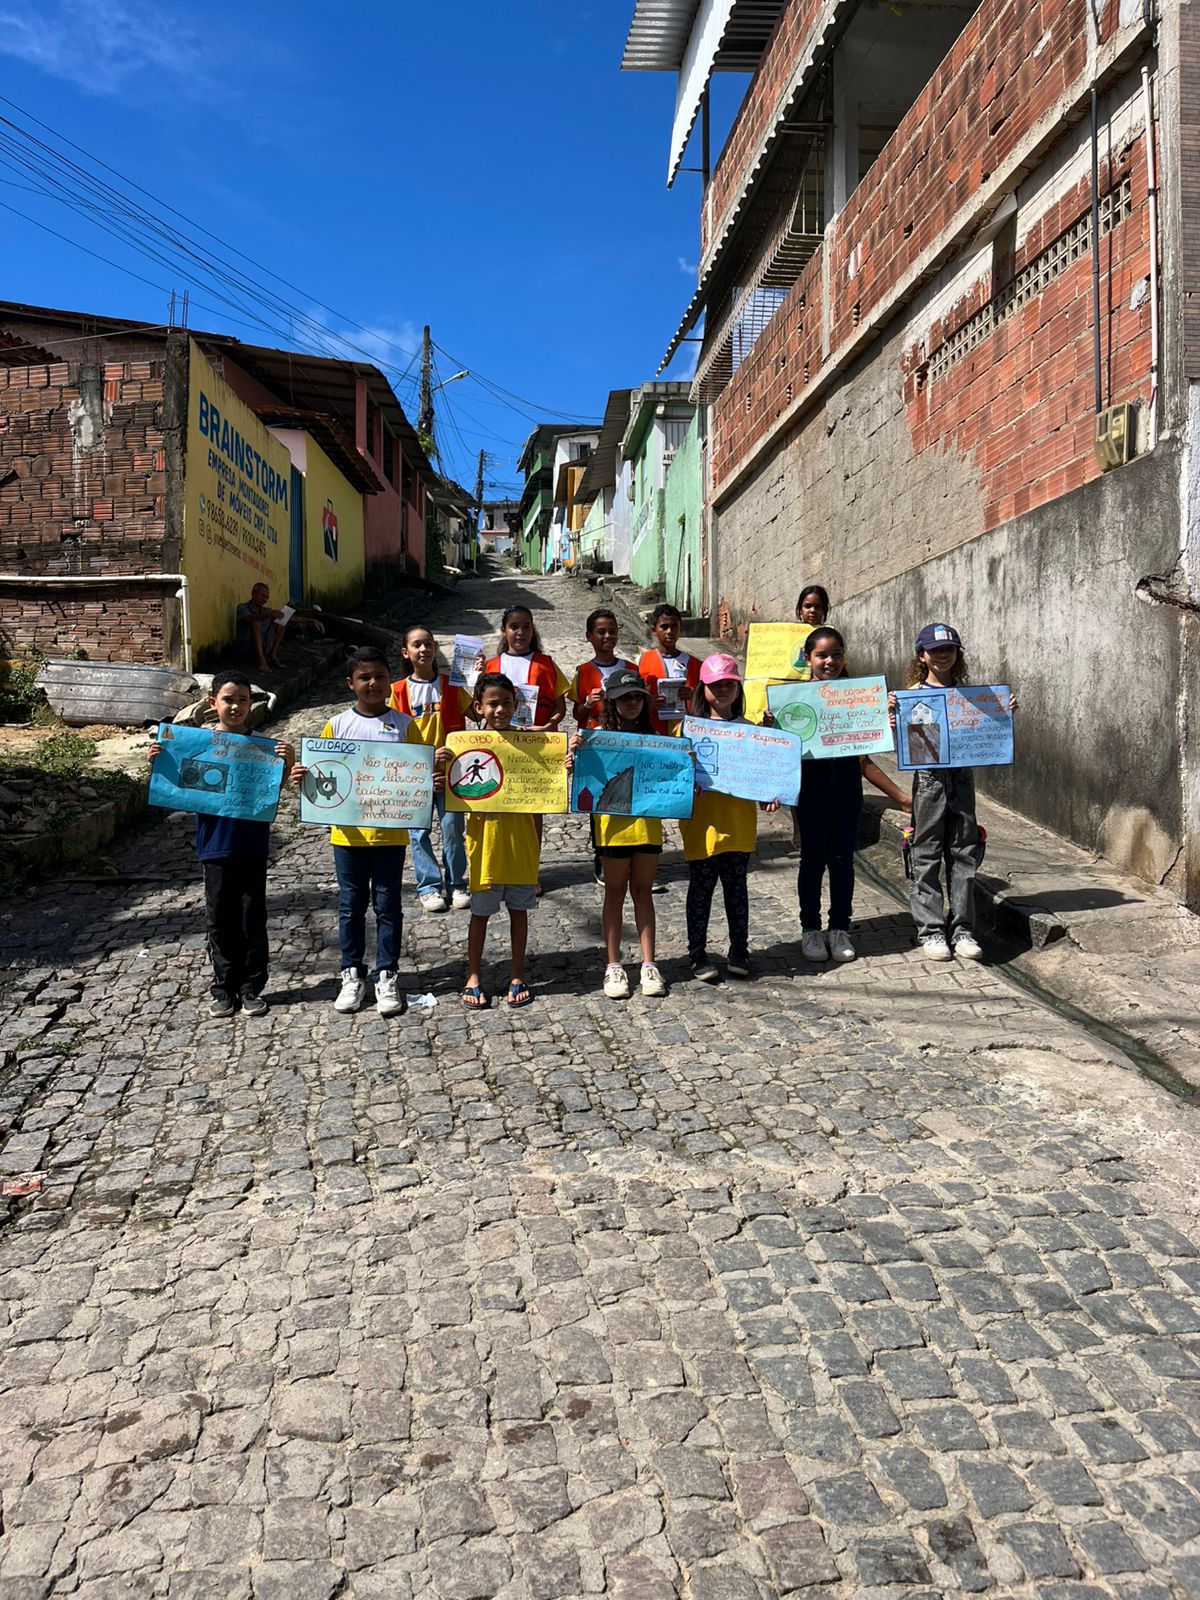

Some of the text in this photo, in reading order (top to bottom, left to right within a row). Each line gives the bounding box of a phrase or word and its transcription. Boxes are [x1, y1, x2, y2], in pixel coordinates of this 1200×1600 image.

[199, 390, 288, 512] BRAINSTORM
[208, 449, 235, 486] EMPRESA
[217, 481, 225, 503] DE
[306, 740, 361, 752] CUIDADO:
[451, 735, 467, 745] EM
[469, 735, 493, 745] CASO
[362, 755, 429, 773] Não toque em
[355, 770, 375, 785] fios
[397, 789, 410, 797] ou
[413, 789, 430, 798] em
[359, 798, 427, 812] equipamentos
[362, 809, 413, 820] molhados
